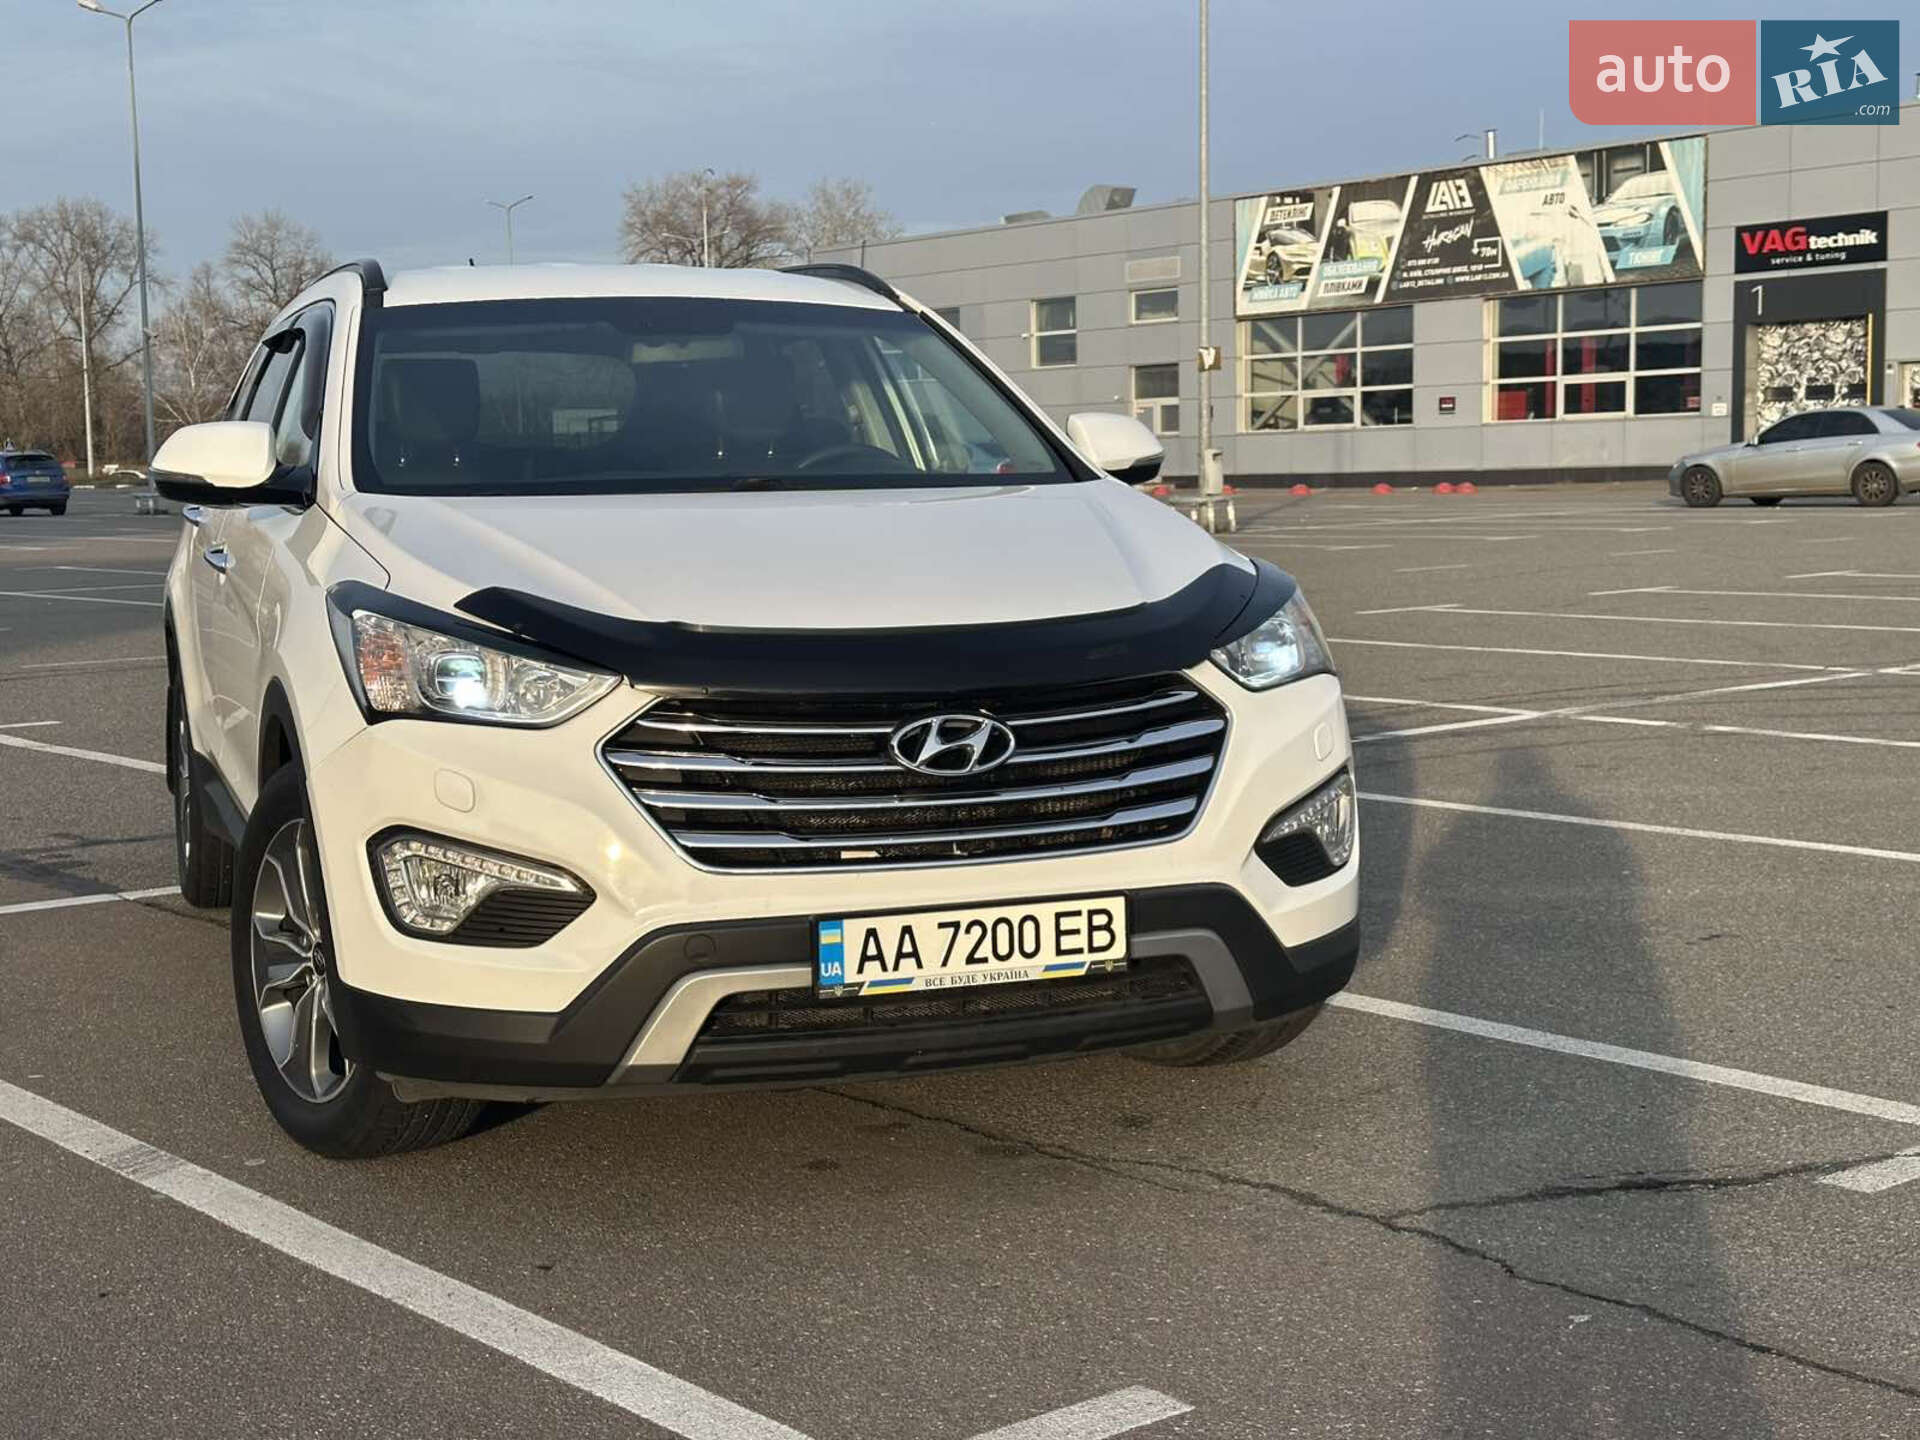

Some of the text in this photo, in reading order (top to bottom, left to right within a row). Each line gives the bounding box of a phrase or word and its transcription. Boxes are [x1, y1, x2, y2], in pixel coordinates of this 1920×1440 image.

[1542, 192, 1565, 207] АВТО
[1771, 250, 1847, 265] service & tuning
[1751, 284, 1764, 316] 1
[856, 908, 1116, 975] AA 7200 EB
[820, 961, 842, 977] UA
[925, 969, 1029, 988] ВСЕ БУДЕ УКРАЇНА
